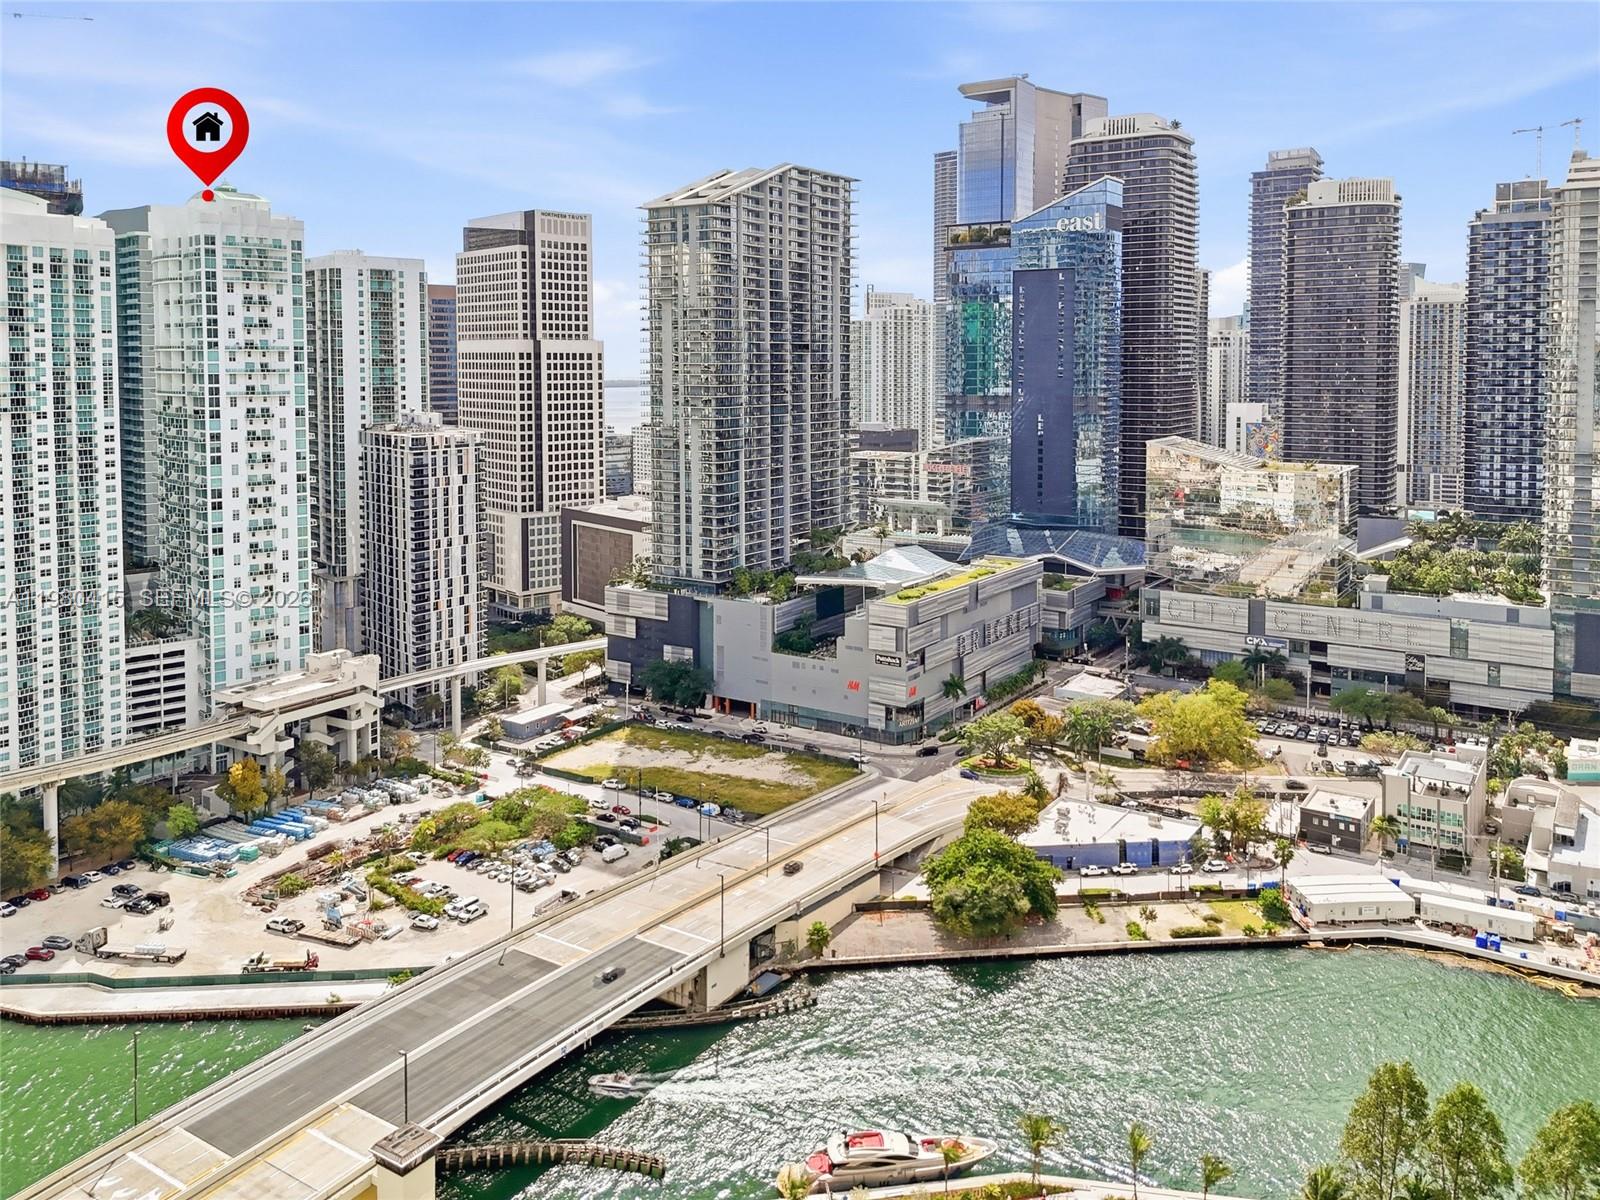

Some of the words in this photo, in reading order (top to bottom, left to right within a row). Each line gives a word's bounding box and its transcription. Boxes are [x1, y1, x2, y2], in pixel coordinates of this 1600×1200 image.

[1056, 212, 1104, 232] east
[1168, 600, 1241, 625] CITY
[1273, 610, 1424, 646] CENTRE
[1246, 636, 1268, 646] CMX
